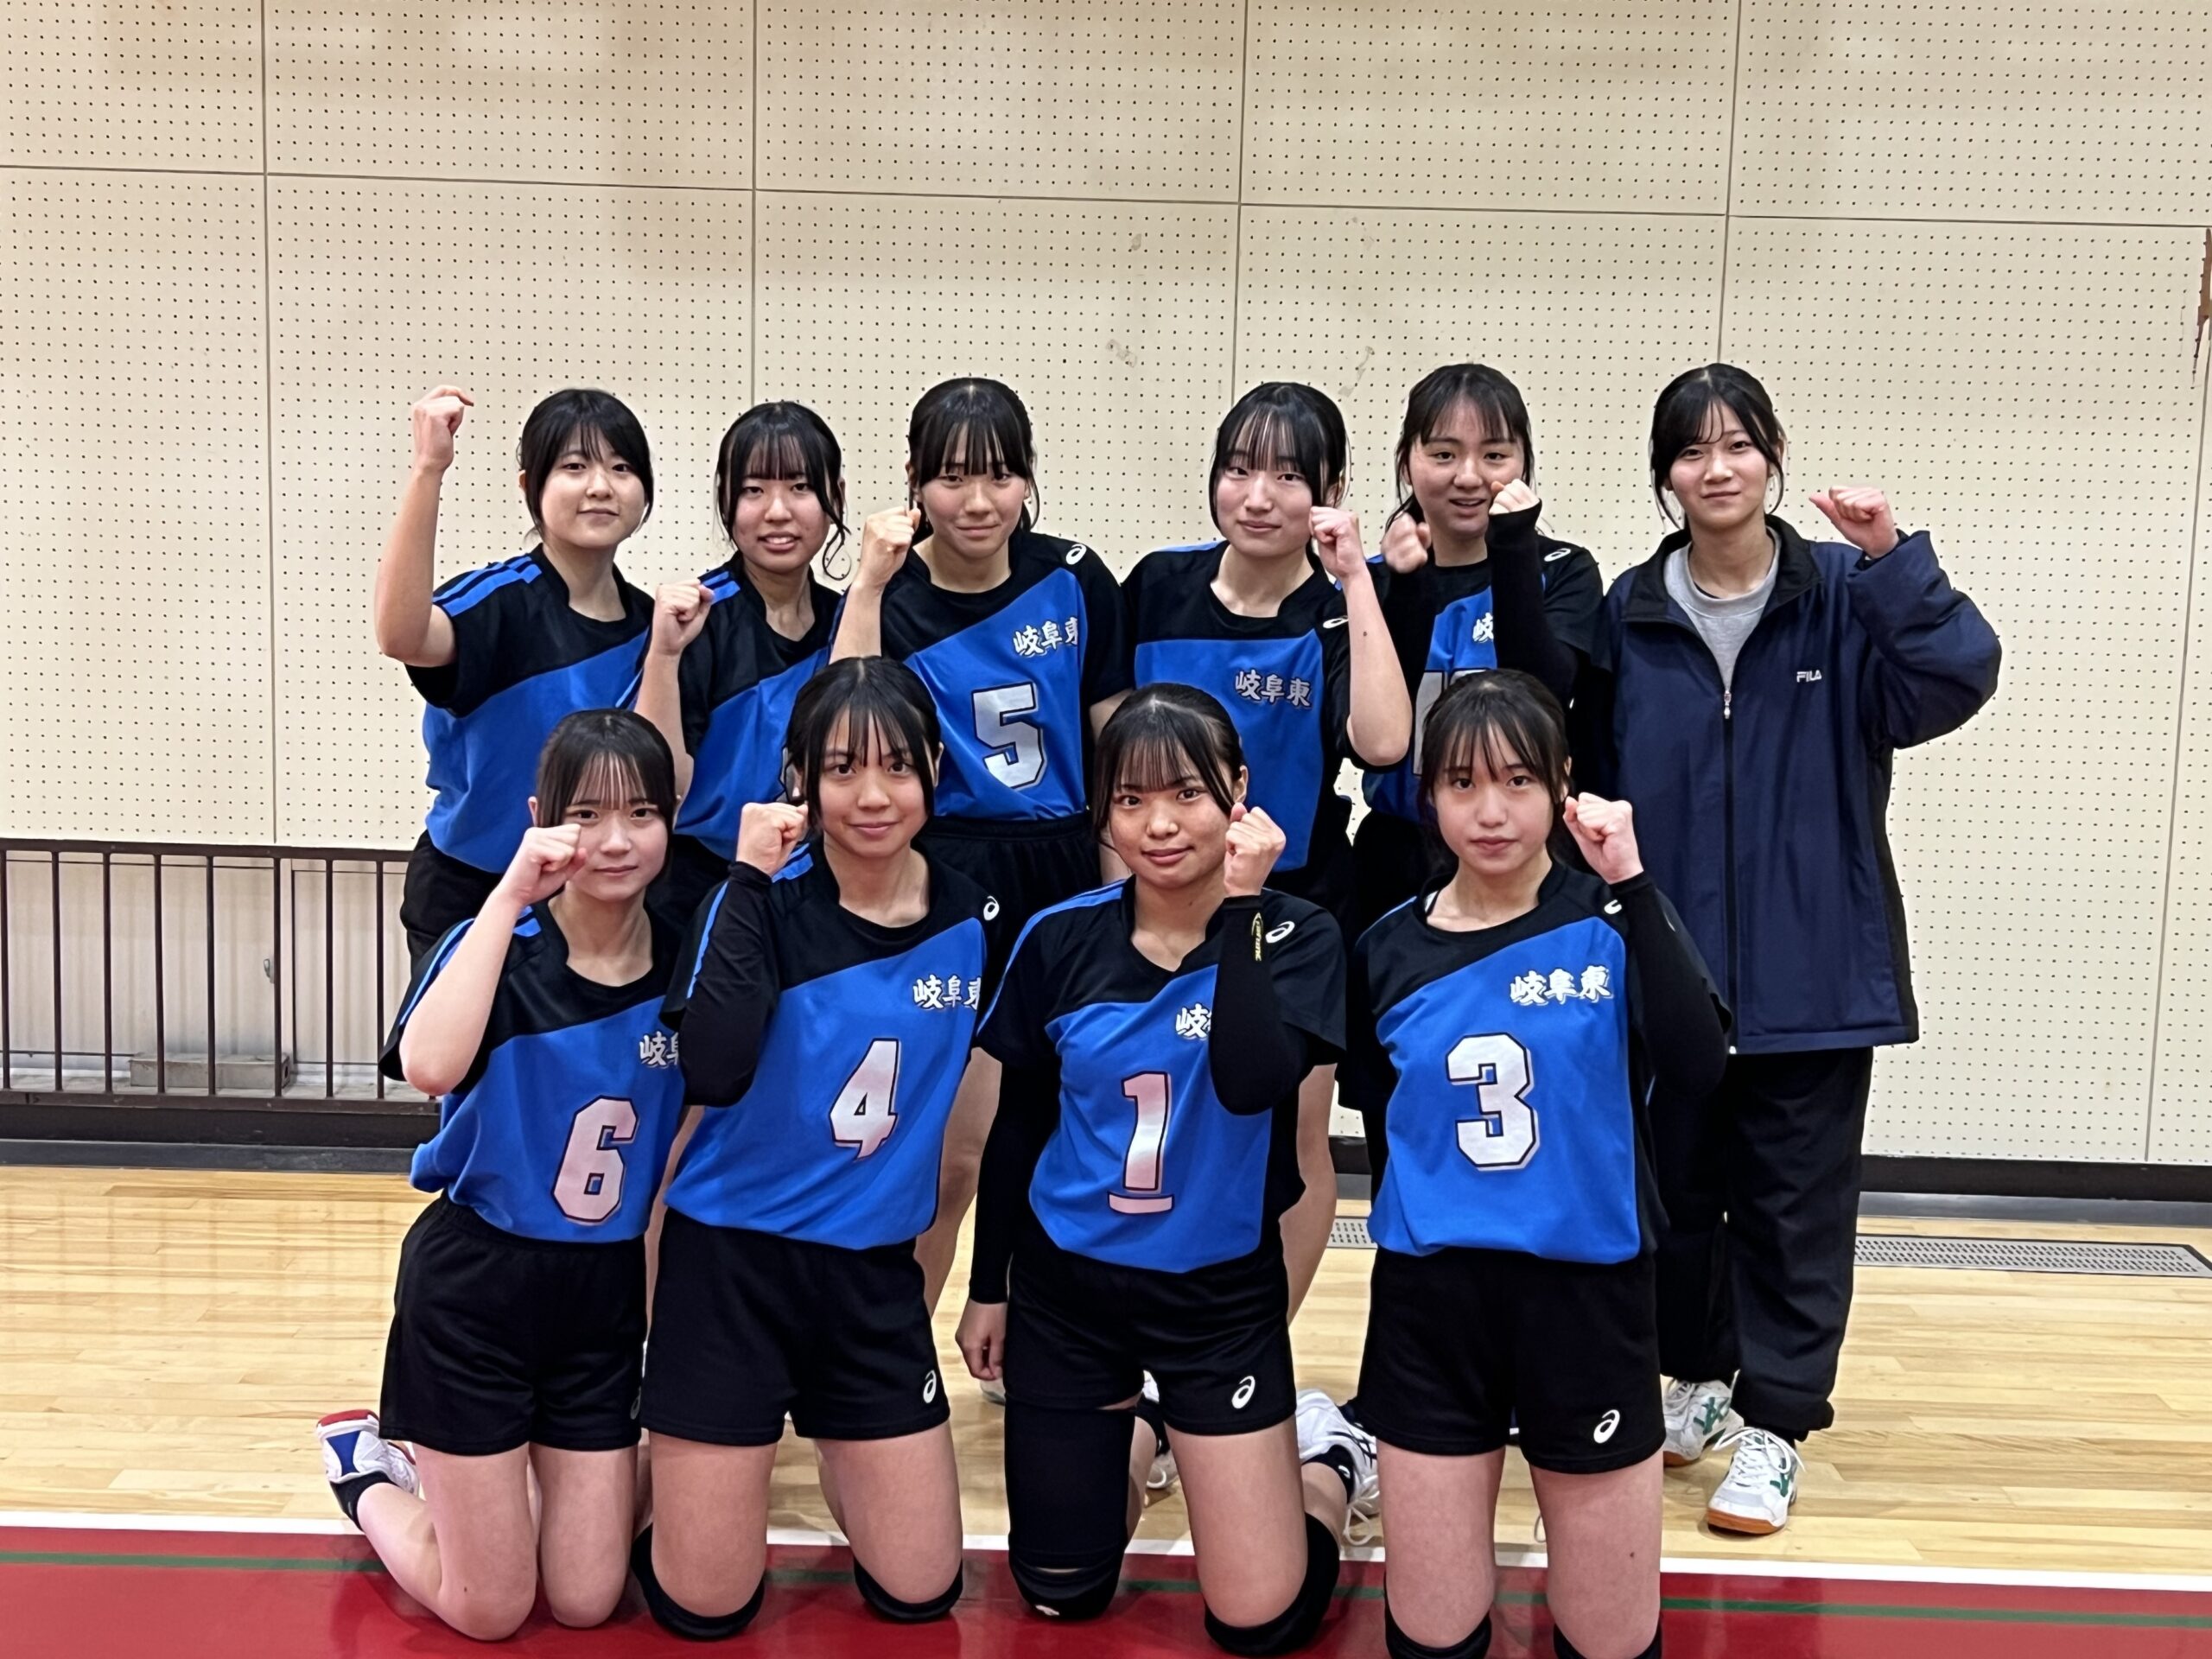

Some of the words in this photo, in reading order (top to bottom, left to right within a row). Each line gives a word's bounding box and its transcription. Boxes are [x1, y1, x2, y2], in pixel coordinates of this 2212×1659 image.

[1235, 669, 1313, 709] 岐阜東
[1796, 670, 1822, 683] FILA
[971, 681, 1047, 791] 5
[1174, 1003, 1211, 1040] 岐
[1510, 964, 1614, 1006] 岐阜東
[830, 1038, 899, 1160] 4
[1107, 1070, 1175, 1215] 1
[1445, 1032, 1541, 1173] 3
[550, 1095, 639, 1224] 6
